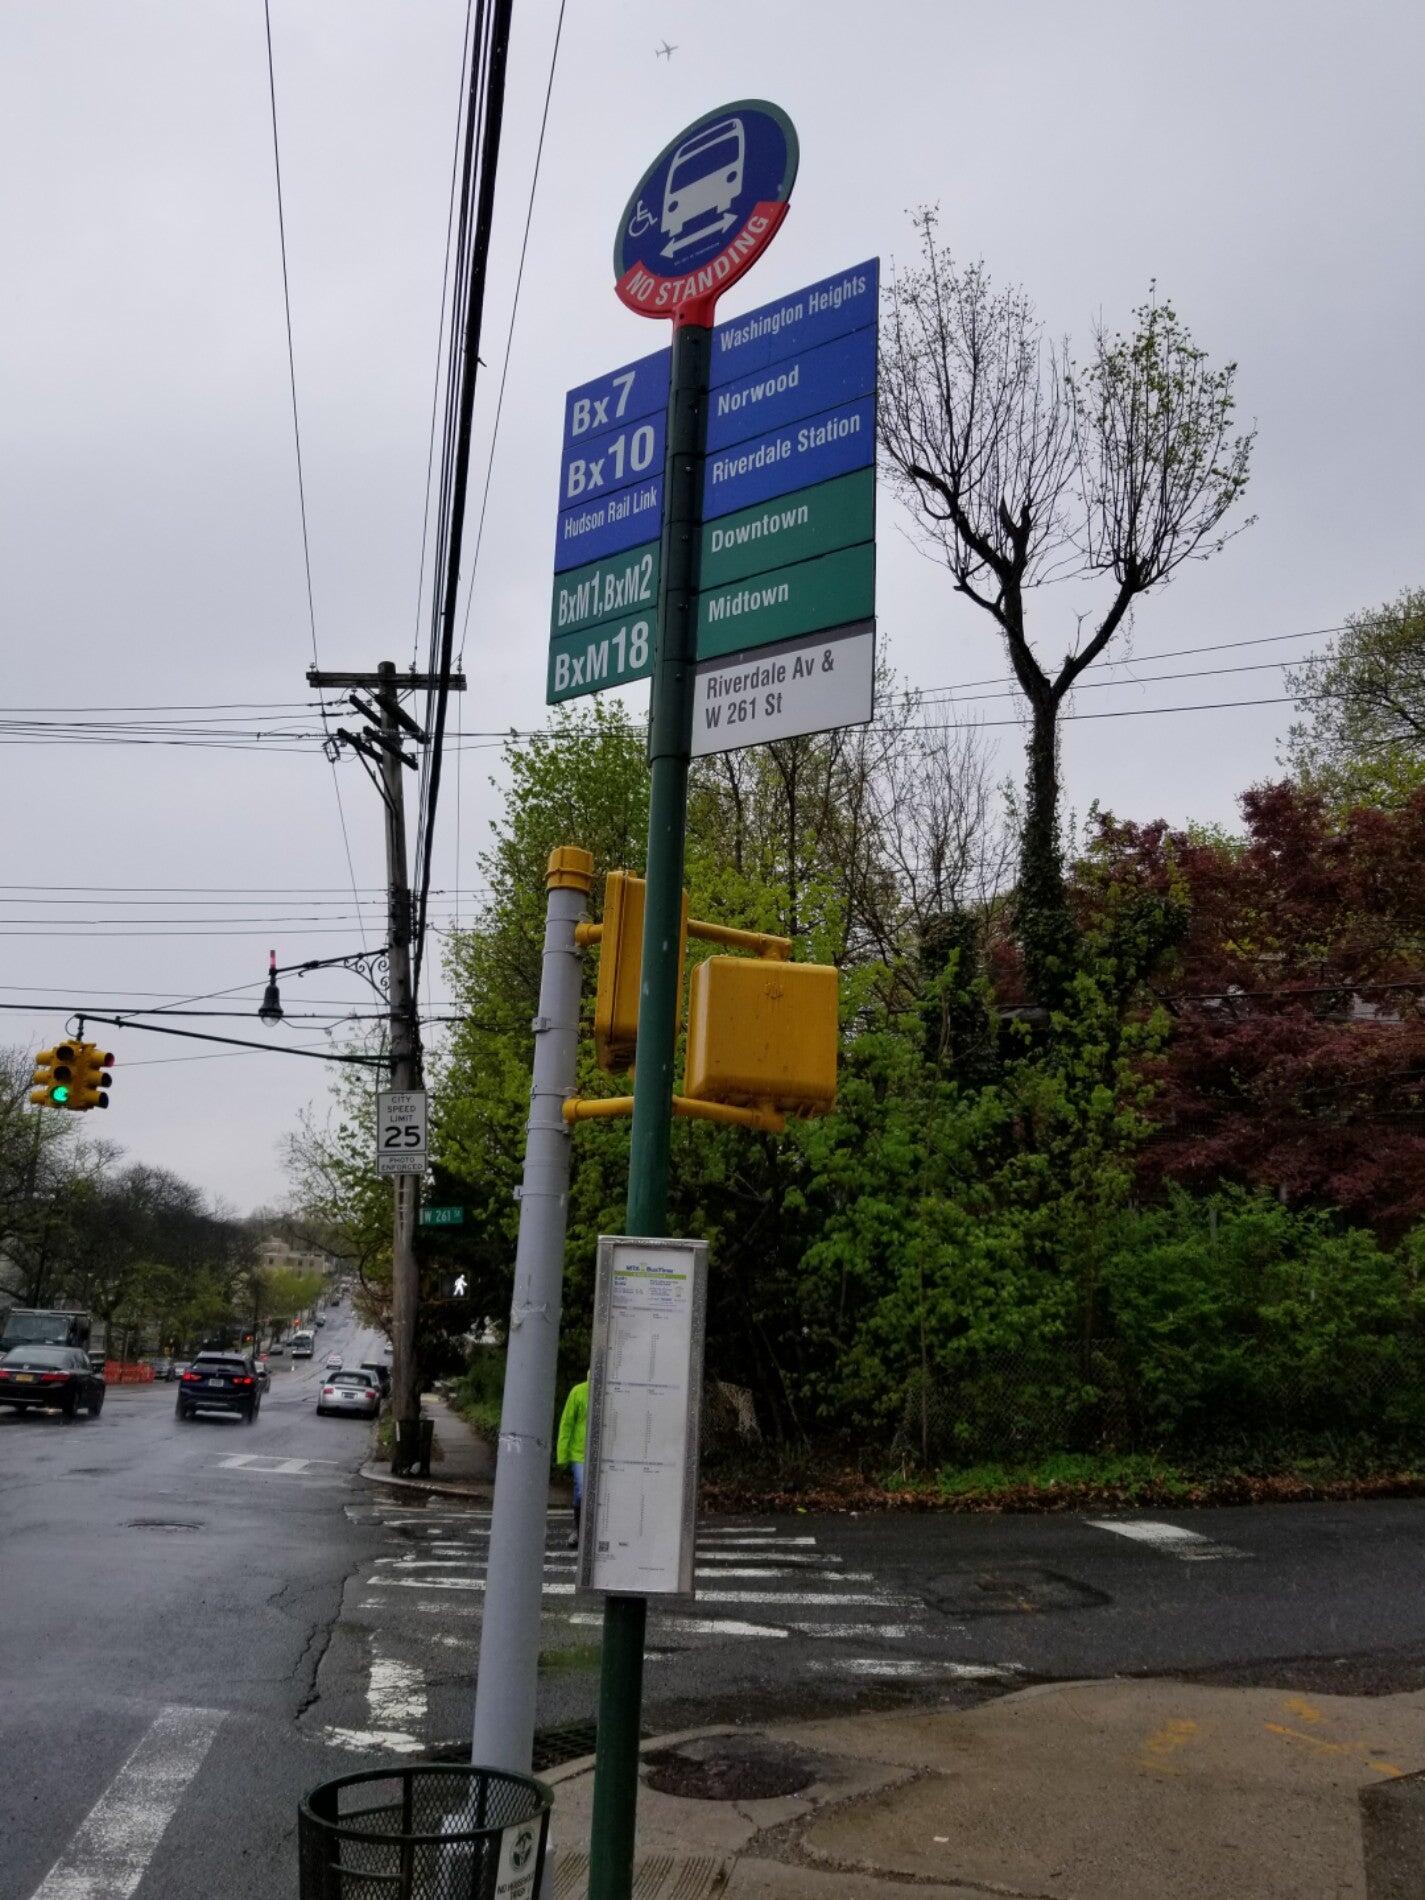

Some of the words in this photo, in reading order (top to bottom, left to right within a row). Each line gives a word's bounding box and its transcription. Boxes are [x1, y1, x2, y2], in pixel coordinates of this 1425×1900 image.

[626, 270, 655, 300] NO
[655, 215, 770, 305] STANDING
[721, 302, 803, 353] Washington
[808, 276, 866, 315] Heights
[572, 370, 636, 437] Bx7
[717, 365, 799, 417] Norwood
[567, 424, 655, 498] Bx10
[713, 440, 791, 485] Riverdale
[797, 414, 861, 453] Station
[564, 499, 605, 540] Hudson
[607, 491, 629, 525] Rail
[632, 485, 657, 516] Link
[711, 504, 809, 553] Downtown
[708, 582, 789, 624] Midtown
[554, 621, 649, 693] BxM18
[707, 665, 786, 701] Riverdale
[792, 654, 815, 681] Av
[822, 648, 835, 673] &
[705, 706, 723, 729] W
[726, 700, 759, 726] 261
[764, 692, 783, 718] St
[387, 1105, 416, 1113] SPEED
[390, 1115, 414, 1123] LIMIT
[391, 1096, 412, 1104] CITY
[384, 1125, 422, 1148] 25
[381, 1163, 423, 1171] ENFORCED
[424, 1210, 432, 1223] W
[436, 1209, 451, 1223] 261
